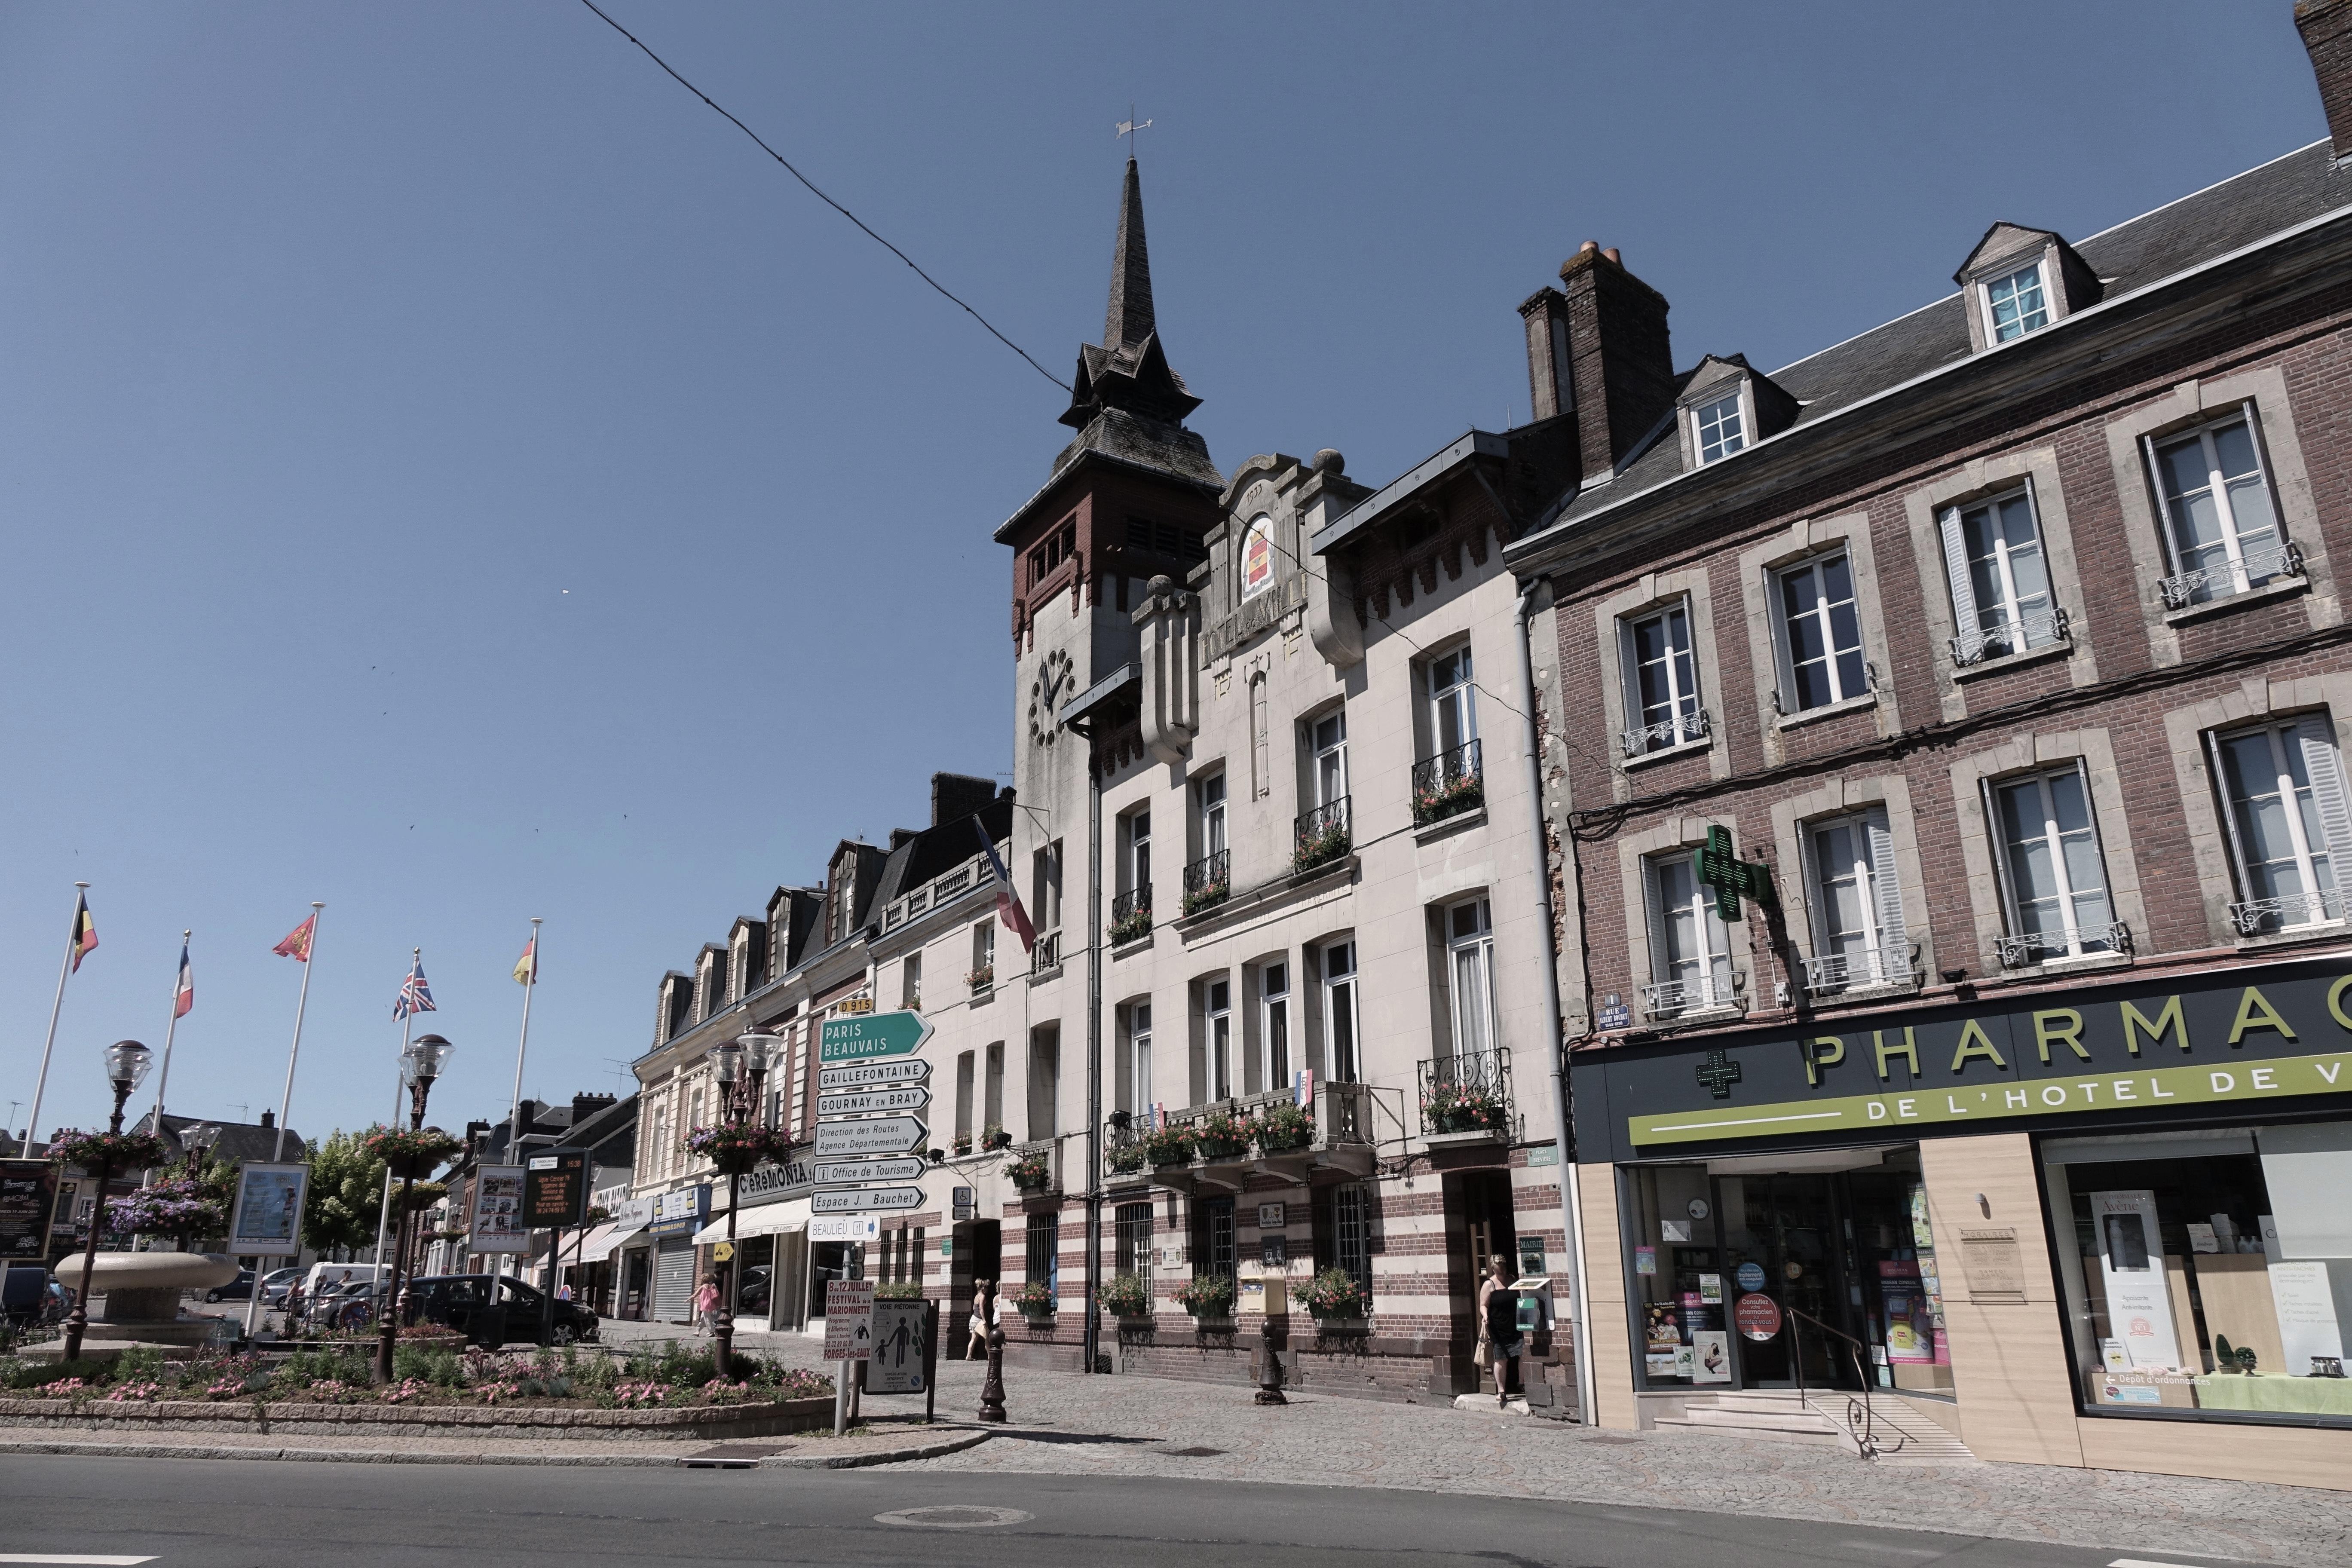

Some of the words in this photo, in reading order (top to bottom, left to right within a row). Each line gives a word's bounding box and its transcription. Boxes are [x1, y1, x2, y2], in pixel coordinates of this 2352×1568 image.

[1246, 483, 1262, 506] 1933
[1202, 613, 1243, 662] HOTEL
[1257, 573, 1308, 621] VILLE
[842, 1002, 847, 1012] D
[851, 999, 870, 1011] 915
[1610, 995, 1614, 1004] 1
[1600, 1015, 1612, 1023] ALBERT
[826, 1023, 861, 1040] PARIS
[825, 1037, 887, 1057] BEAUVAIS
[823, 1064, 919, 1084] GAILLEFONTAINE
[1868, 1099, 1917, 1120] DE
[1948, 1077, 2174, 1113] L'HOTEL
[2210, 1068, 2278, 1093] DE
[821, 1096, 872, 1111] GOURNAY
[889, 1092, 919, 1105] BRAY
[820, 1127, 853, 1138] Direction
[857, 1125, 870, 1135] des
[873, 1124, 900, 1133] Routes
[819, 1140, 846, 1152] Agence
[849, 1136, 909, 1149] Départementale
[832, 1166, 858, 1178] Office
[861, 1166, 871, 1176] de
[876, 1164, 914, 1175] Tourisme
[816, 1196, 848, 1210] Espace
[854, 1194, 862, 1206] J.
[873, 1193, 913, 1205] Bauchet
[2103, 1200, 2139, 1212] Avène
[812, 1221, 847, 1236] BEAULIEU
[829, 1282, 834, 1292] 8
[839, 1282, 847, 1292] 12
[848, 1282, 873, 1292] JUILLET
[827, 1295, 861, 1305] FESTIVAL
[827, 1305, 870, 1315] MARIONNETTE
[824, 1348, 870, 1359] FORGES-les-EAUX
[2119, 1375, 2144, 1384] Dépôt
[2147, 1375, 2211, 1385] d'ordonnances
